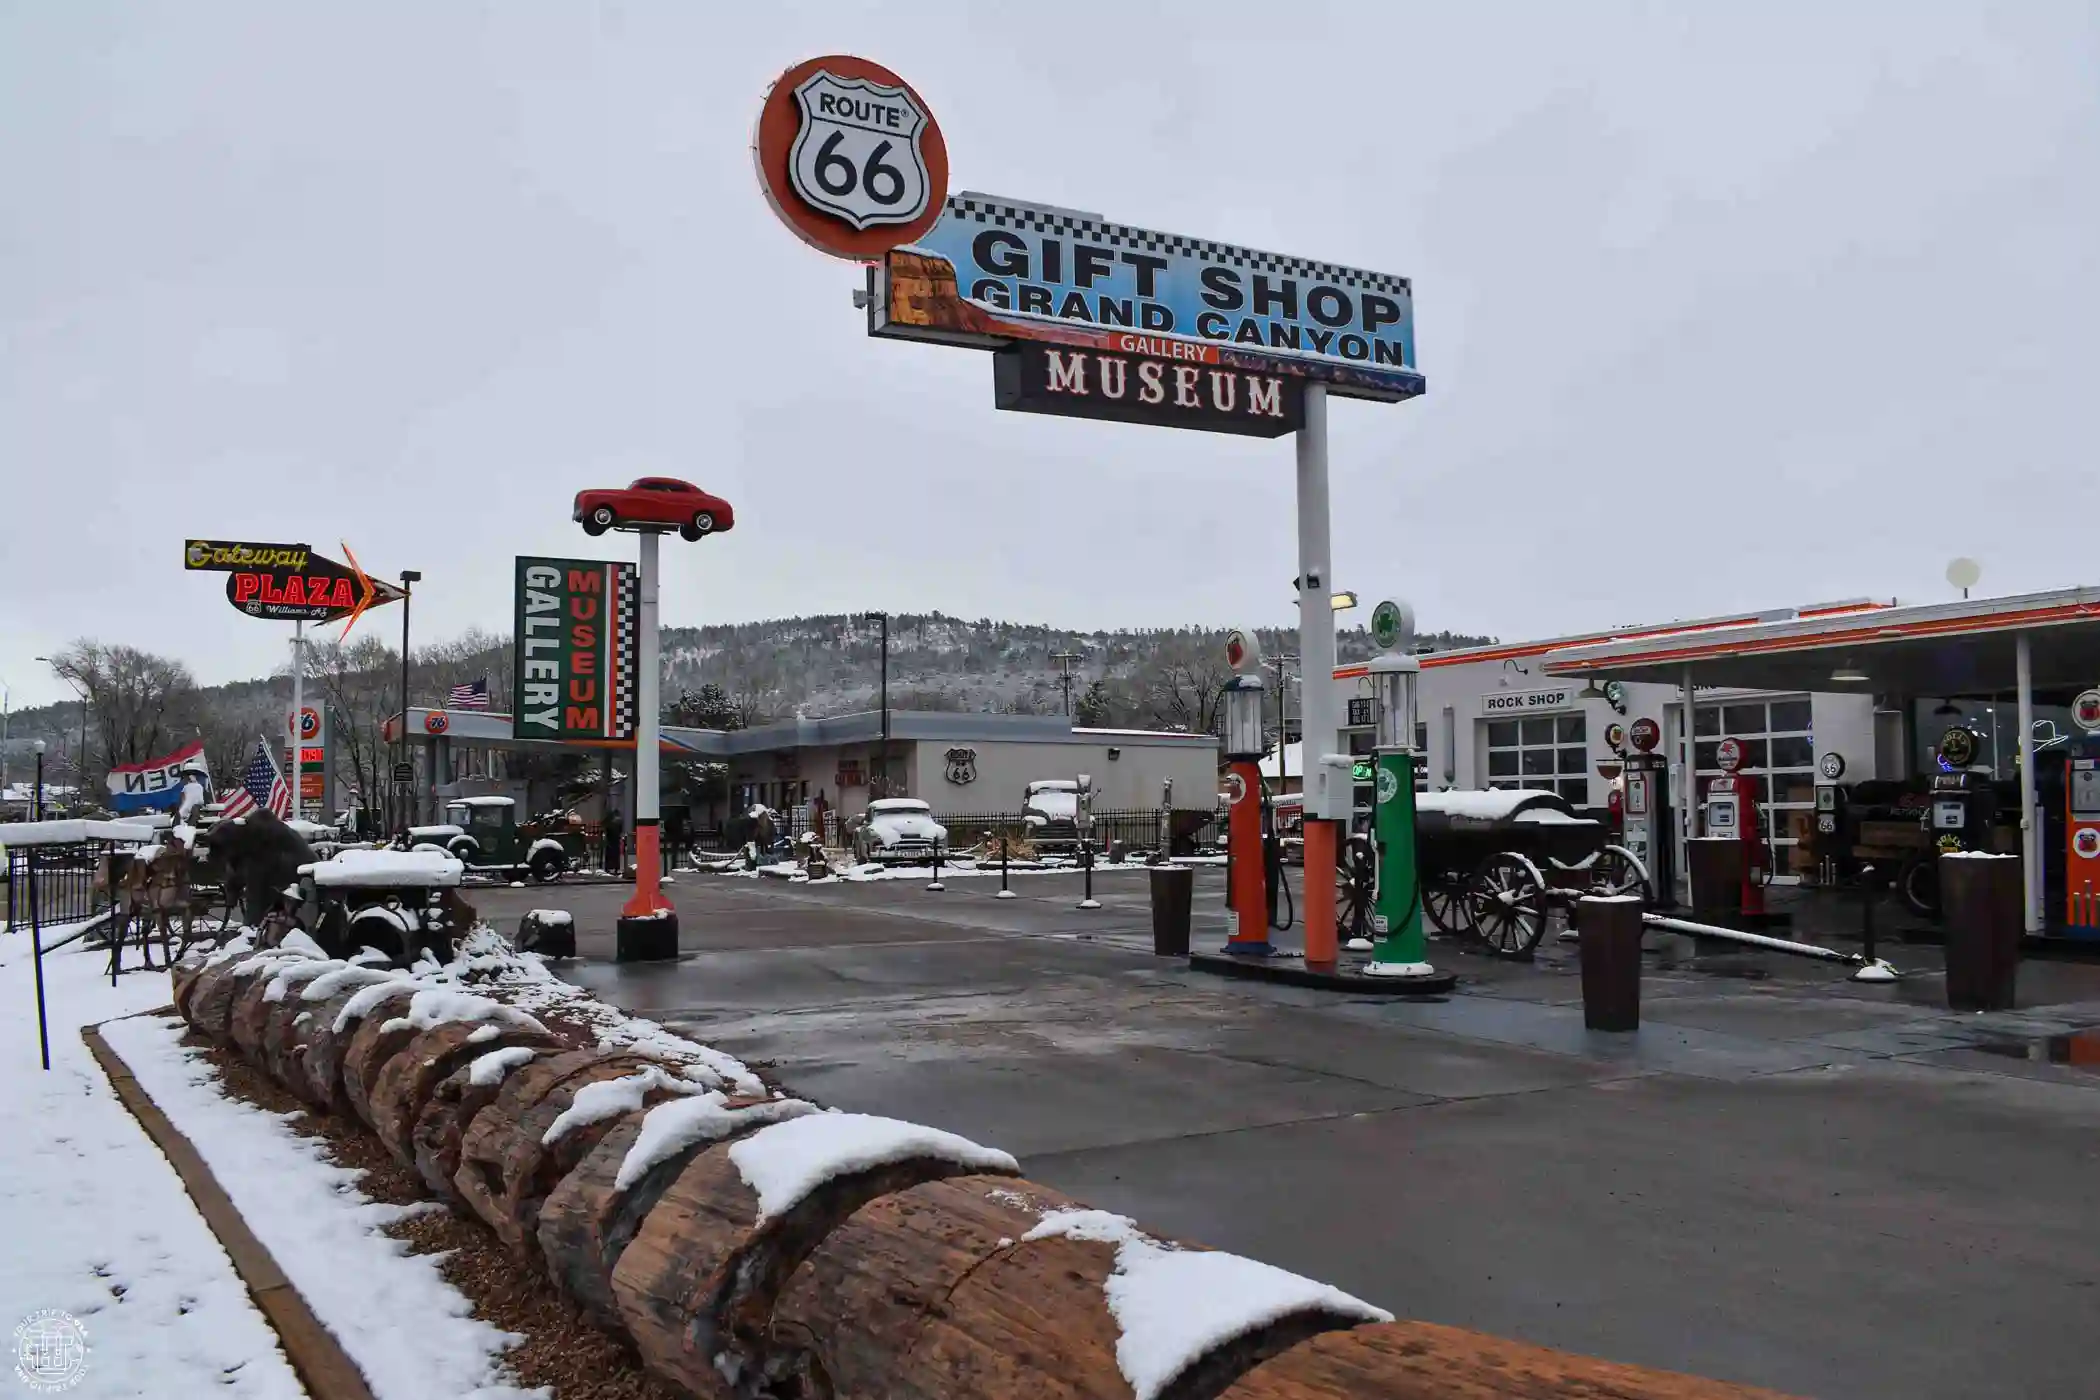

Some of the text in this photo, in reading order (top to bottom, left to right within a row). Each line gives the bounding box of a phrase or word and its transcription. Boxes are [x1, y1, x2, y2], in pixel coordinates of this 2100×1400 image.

[814, 130, 905, 205] 66
[972, 230, 1400, 333] GIFT SHOP
[971, 278, 1403, 366] GRAND CANYON
[1120, 335, 1207, 361] GALLERY
[1044, 350, 1284, 417] MUSEUM
[187, 541, 308, 571] Gateway
[235, 573, 355, 606] PLAZA
[524, 566, 561, 730] GALLERY
[566, 569, 600, 729] MUSEUM
[1488, 693, 1564, 708] ROCK SHOP
[431, 716, 446, 728] 76
[953, 767, 969, 780] 66
[1824, 763, 1836, 773] 66
[1820, 818, 1833, 829] 66
